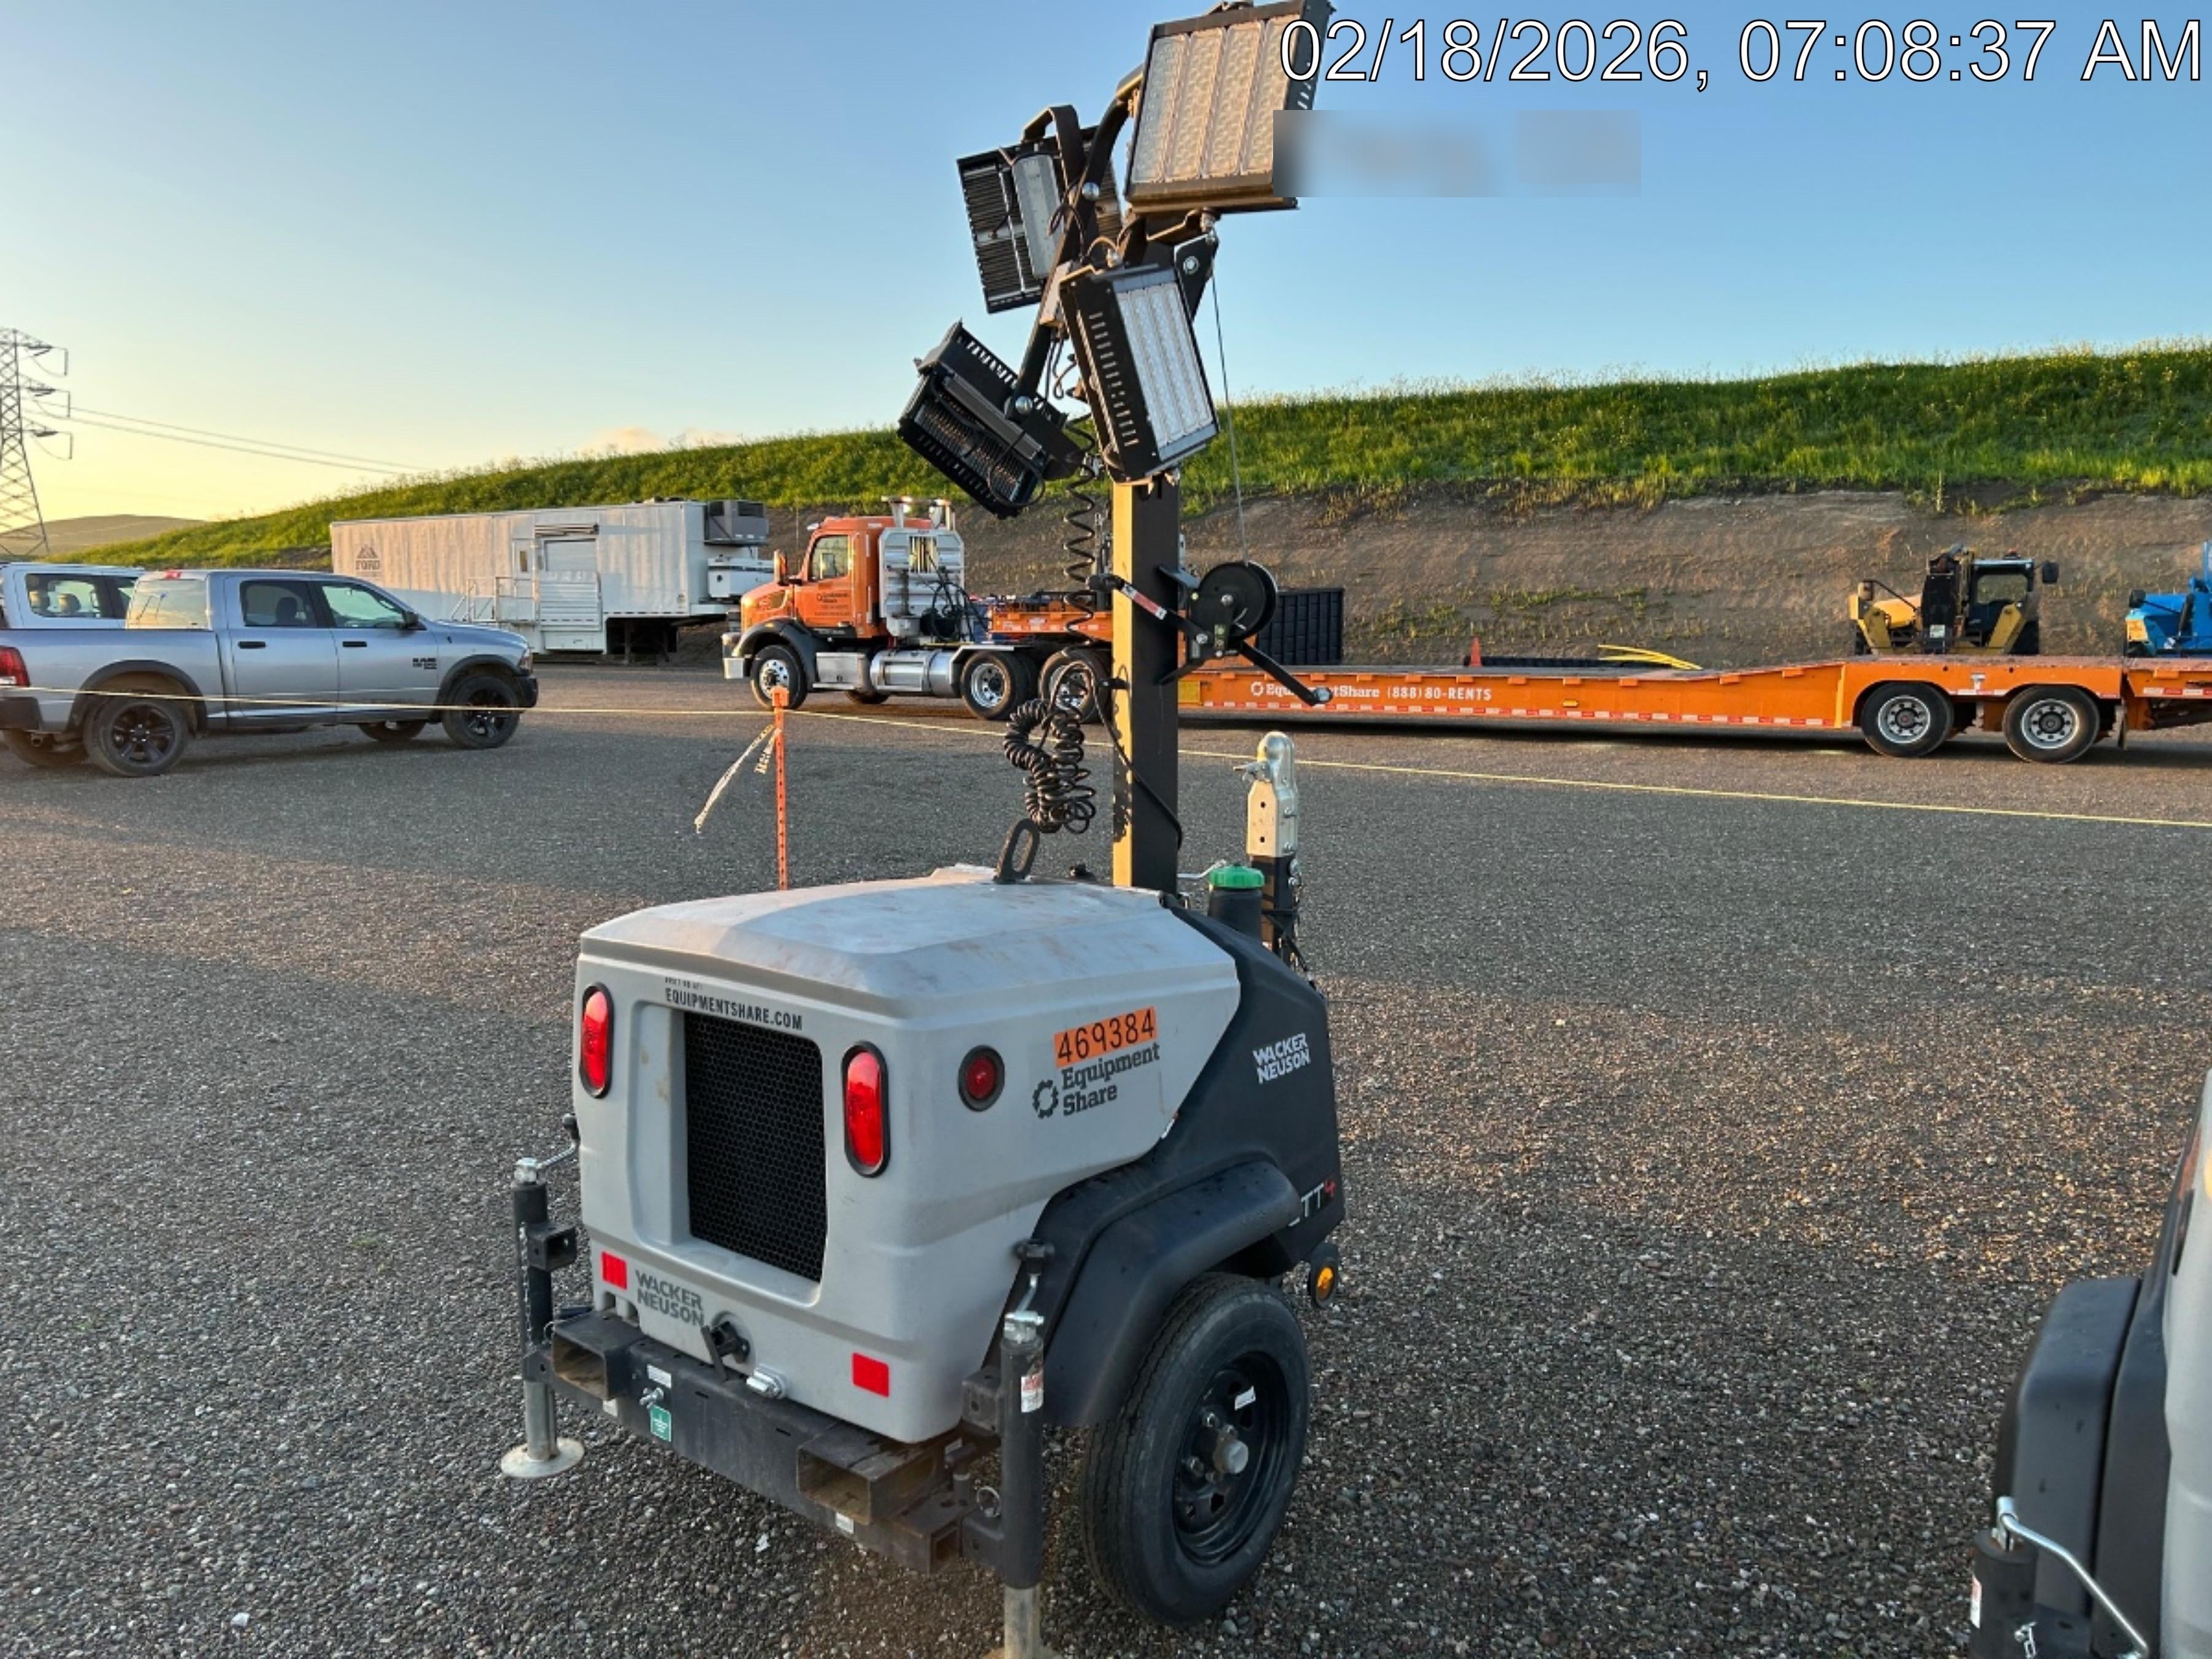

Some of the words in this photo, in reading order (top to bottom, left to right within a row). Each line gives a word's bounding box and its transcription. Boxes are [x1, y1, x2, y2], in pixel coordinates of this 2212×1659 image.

[1425, 687, 1492, 701] 80-RENTS
[665, 987, 802, 1030] EQUIPMENTSHARE.COM
[1057, 1009, 1155, 1062] 469384
[1253, 1033, 1308, 1066] WACKER
[1062, 1042, 1160, 1089] Equipment
[1257, 1048, 1311, 1084] NEUSON
[1063, 1084, 1118, 1116] Share
[635, 1269, 703, 1311] WACKER
[638, 1287, 704, 1328] NEUSON
